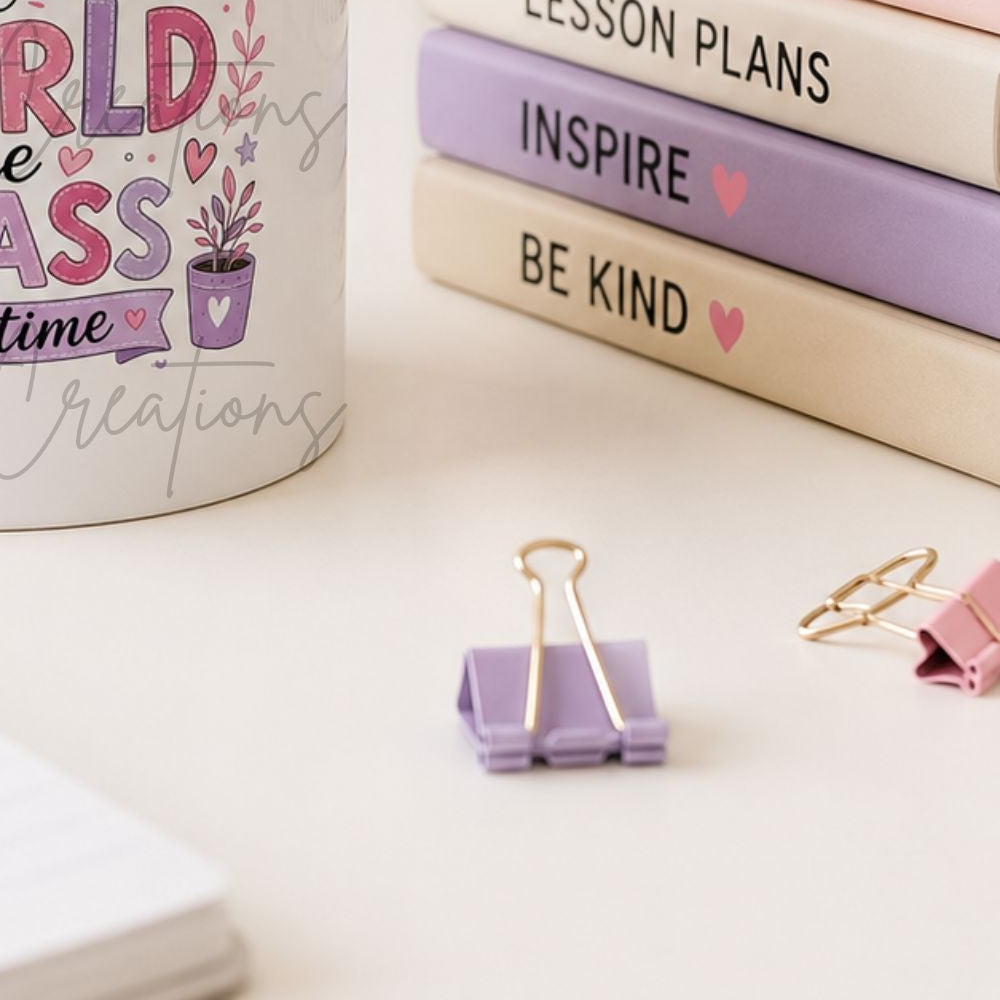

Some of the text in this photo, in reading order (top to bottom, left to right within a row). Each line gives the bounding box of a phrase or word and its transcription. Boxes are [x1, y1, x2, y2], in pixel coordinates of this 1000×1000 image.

[695, 17, 831, 105] PLANS
[521, 99, 692, 204] INSPIRE
[520, 231, 689, 336] BE KIND
